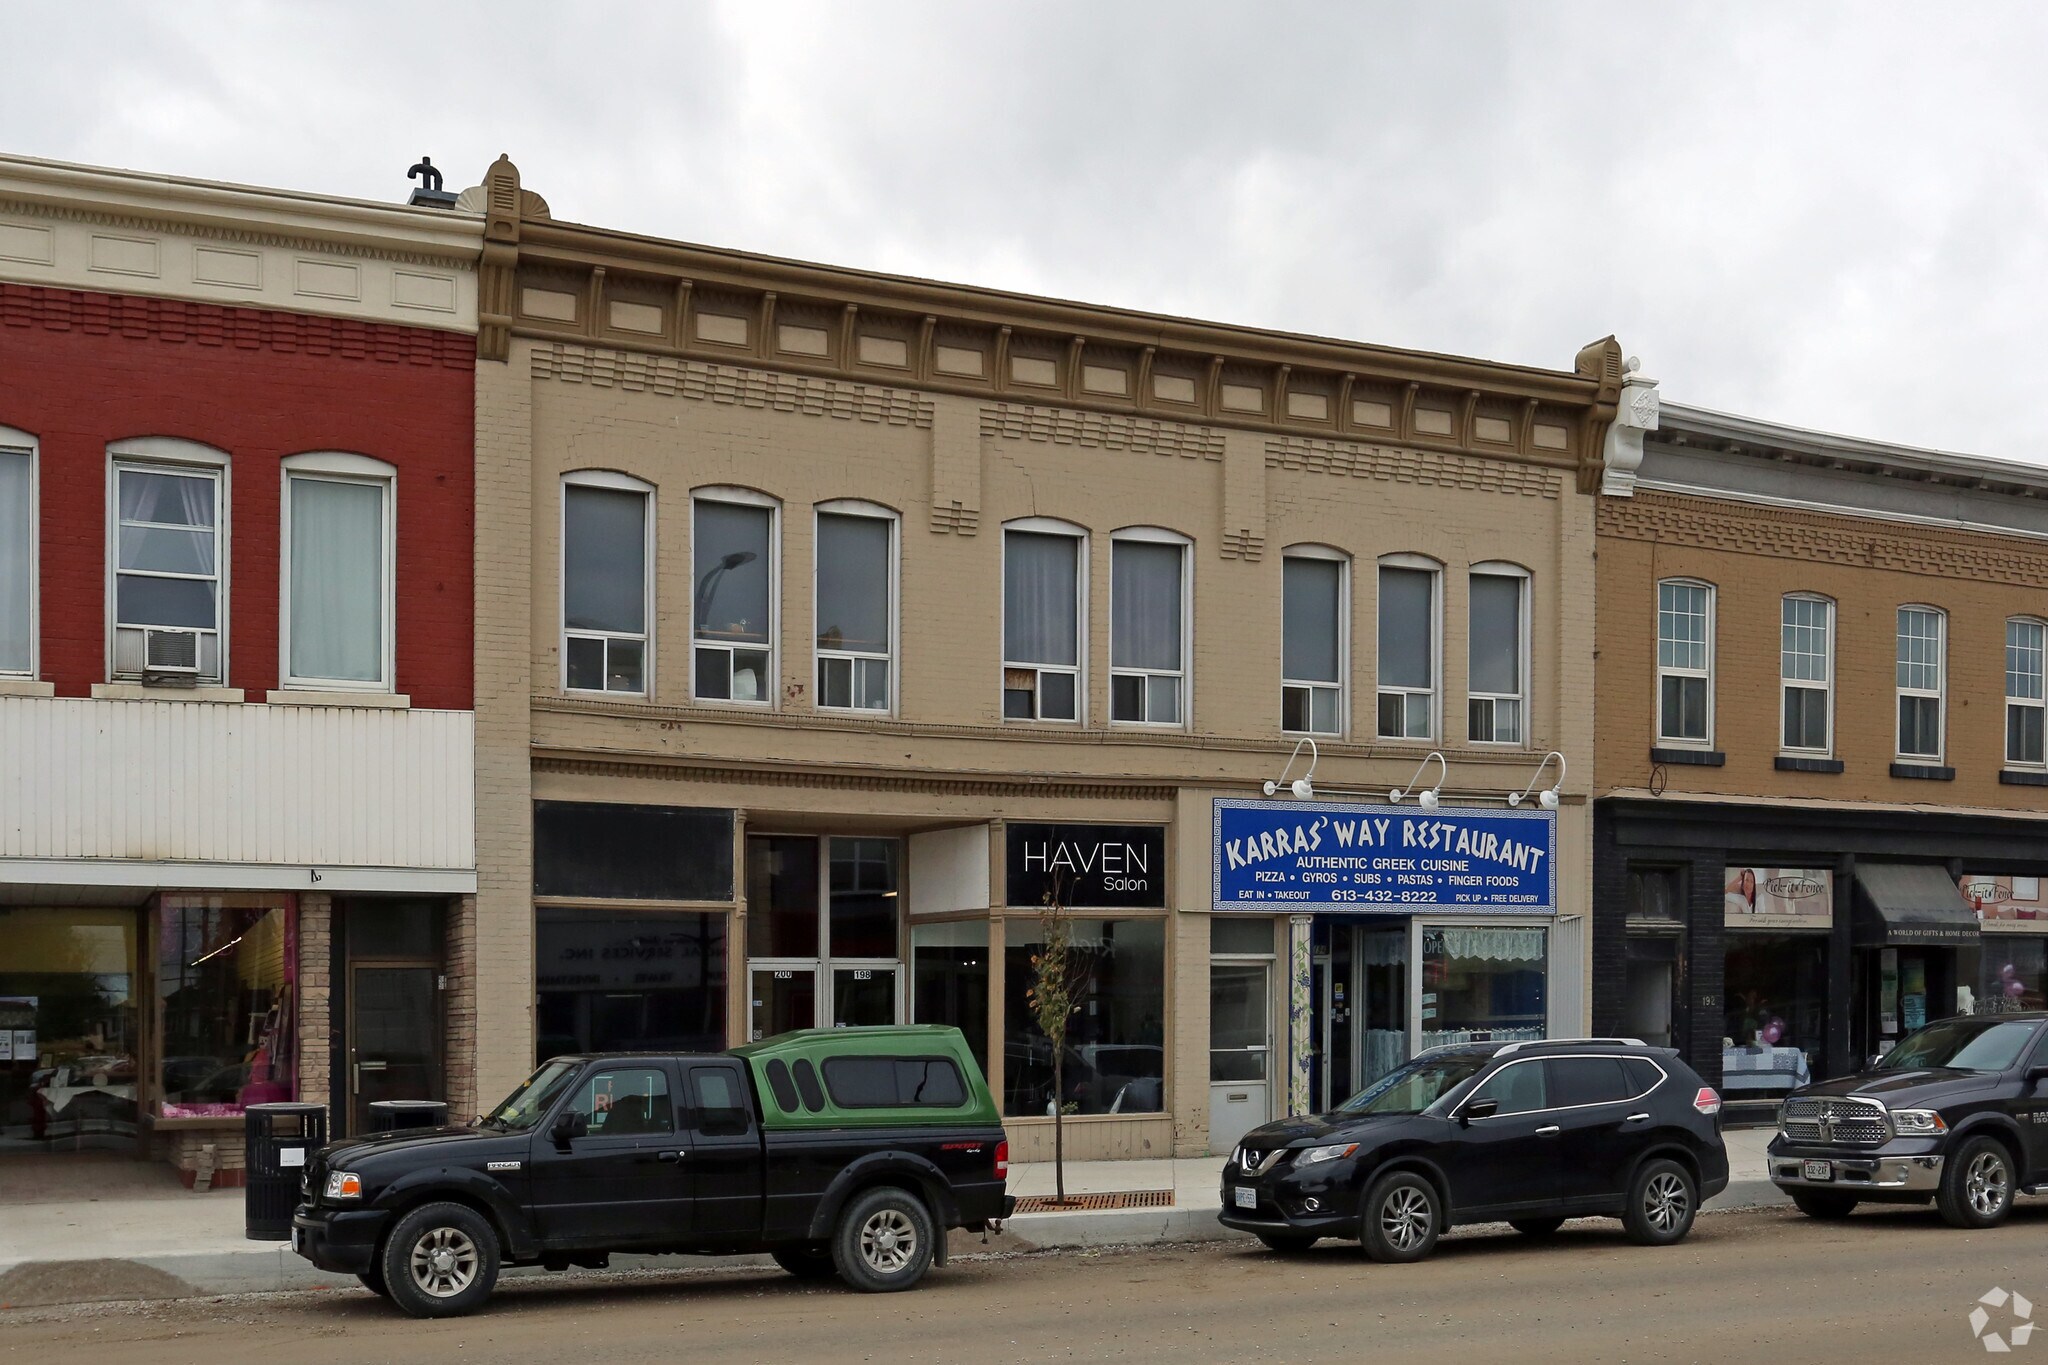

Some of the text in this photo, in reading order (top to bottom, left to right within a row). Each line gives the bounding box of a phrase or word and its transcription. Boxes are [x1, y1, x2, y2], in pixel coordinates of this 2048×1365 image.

[1225, 816, 1546, 875] KARRAS' WAY RESTAURANT
[1025, 841, 1147, 874] HAVEN
[1296, 856, 1470, 872] AUTHENTIC GREEK CUISINE
[1103, 876, 1147, 891] Salon
[1255, 871, 1519, 887] PIZZA GYROS SUBS PASTAS FINGER FOODS
[1238, 890, 1264, 899] EAT IN
[1274, 891, 1310, 900] TAKEOUT
[1331, 889, 1437, 903] 613-432-8222
[1455, 894, 1482, 902] PICK UP
[1491, 894, 1538, 903] FREE DELIVERY
[775, 971, 791, 979] 200
[855, 970, 871, 979] 198
[1702, 995, 1716, 1006] 192
